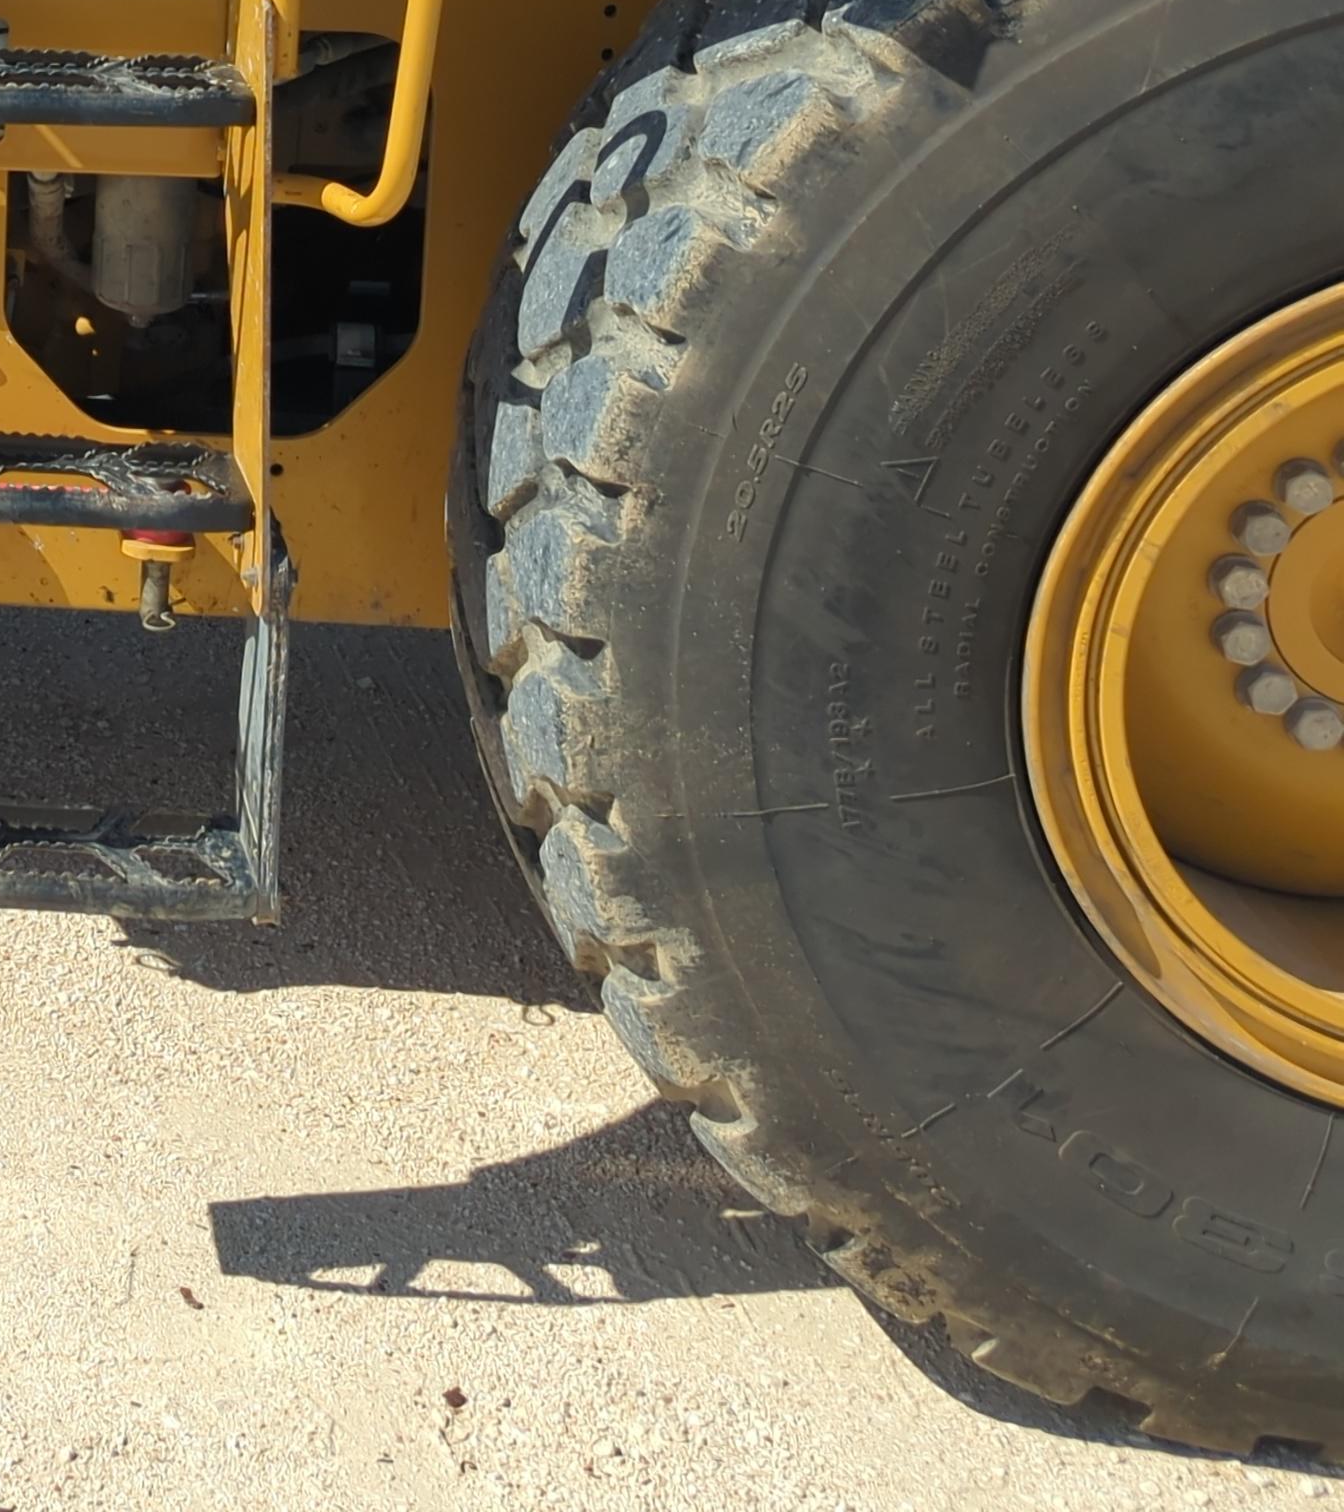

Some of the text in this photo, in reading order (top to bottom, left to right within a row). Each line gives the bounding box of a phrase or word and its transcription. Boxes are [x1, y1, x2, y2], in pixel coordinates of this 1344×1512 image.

[726, 361, 809, 542] 20.5R25
[918, 529, 968, 654] STEEL
[959, 320, 1105, 513] TUBELESS
[975, 377, 1095, 578] CONSTRUCTION
